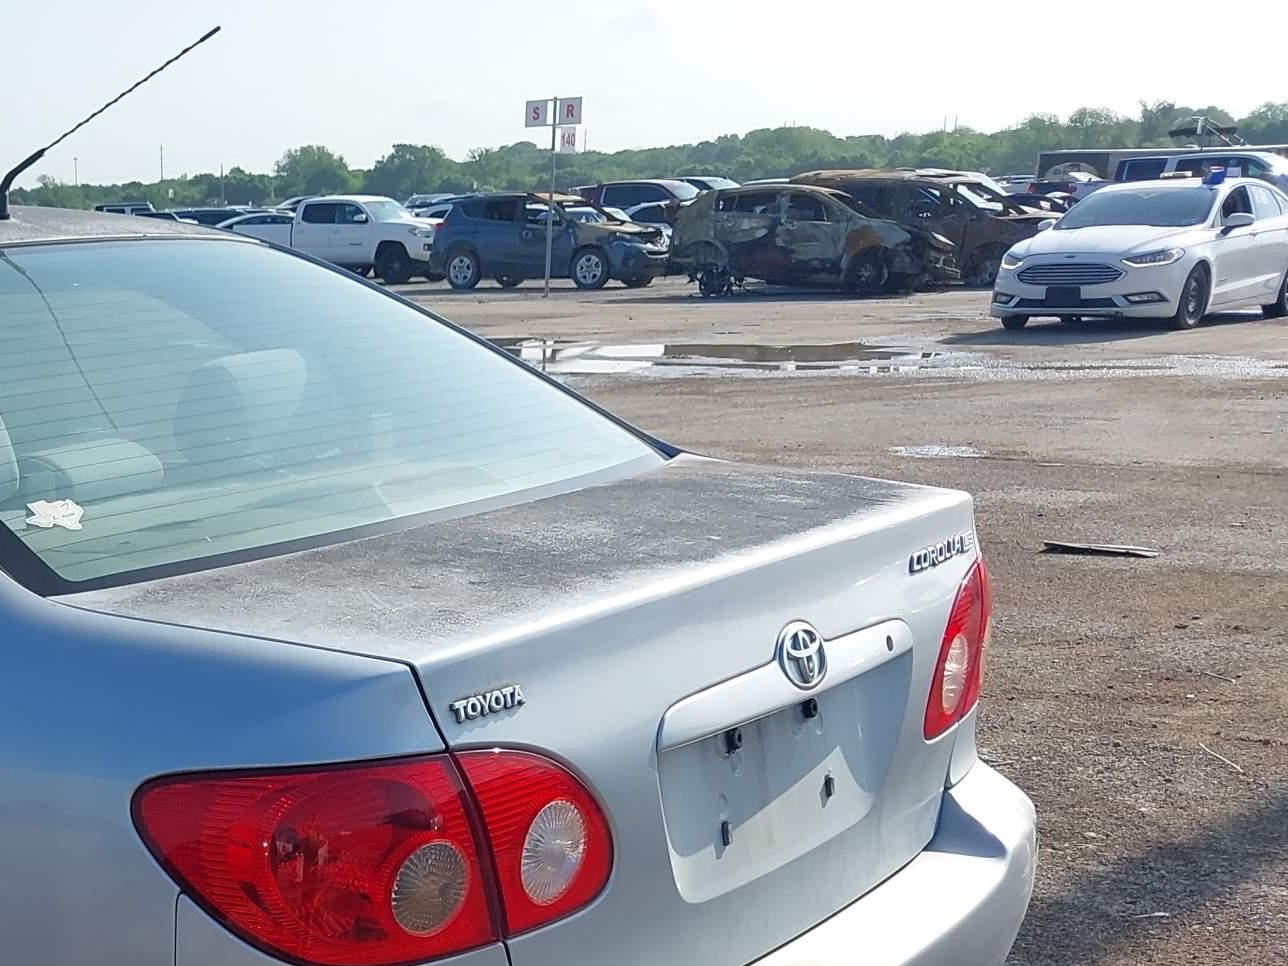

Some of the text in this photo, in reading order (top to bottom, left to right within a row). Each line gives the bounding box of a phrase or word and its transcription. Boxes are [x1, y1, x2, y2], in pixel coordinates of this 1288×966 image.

[532, 106, 540, 121] S
[566, 103, 575, 119] R
[561, 132, 576, 147] 140
[909, 534, 964, 573] COROLLA
[450, 684, 527, 724] TOYOTA
